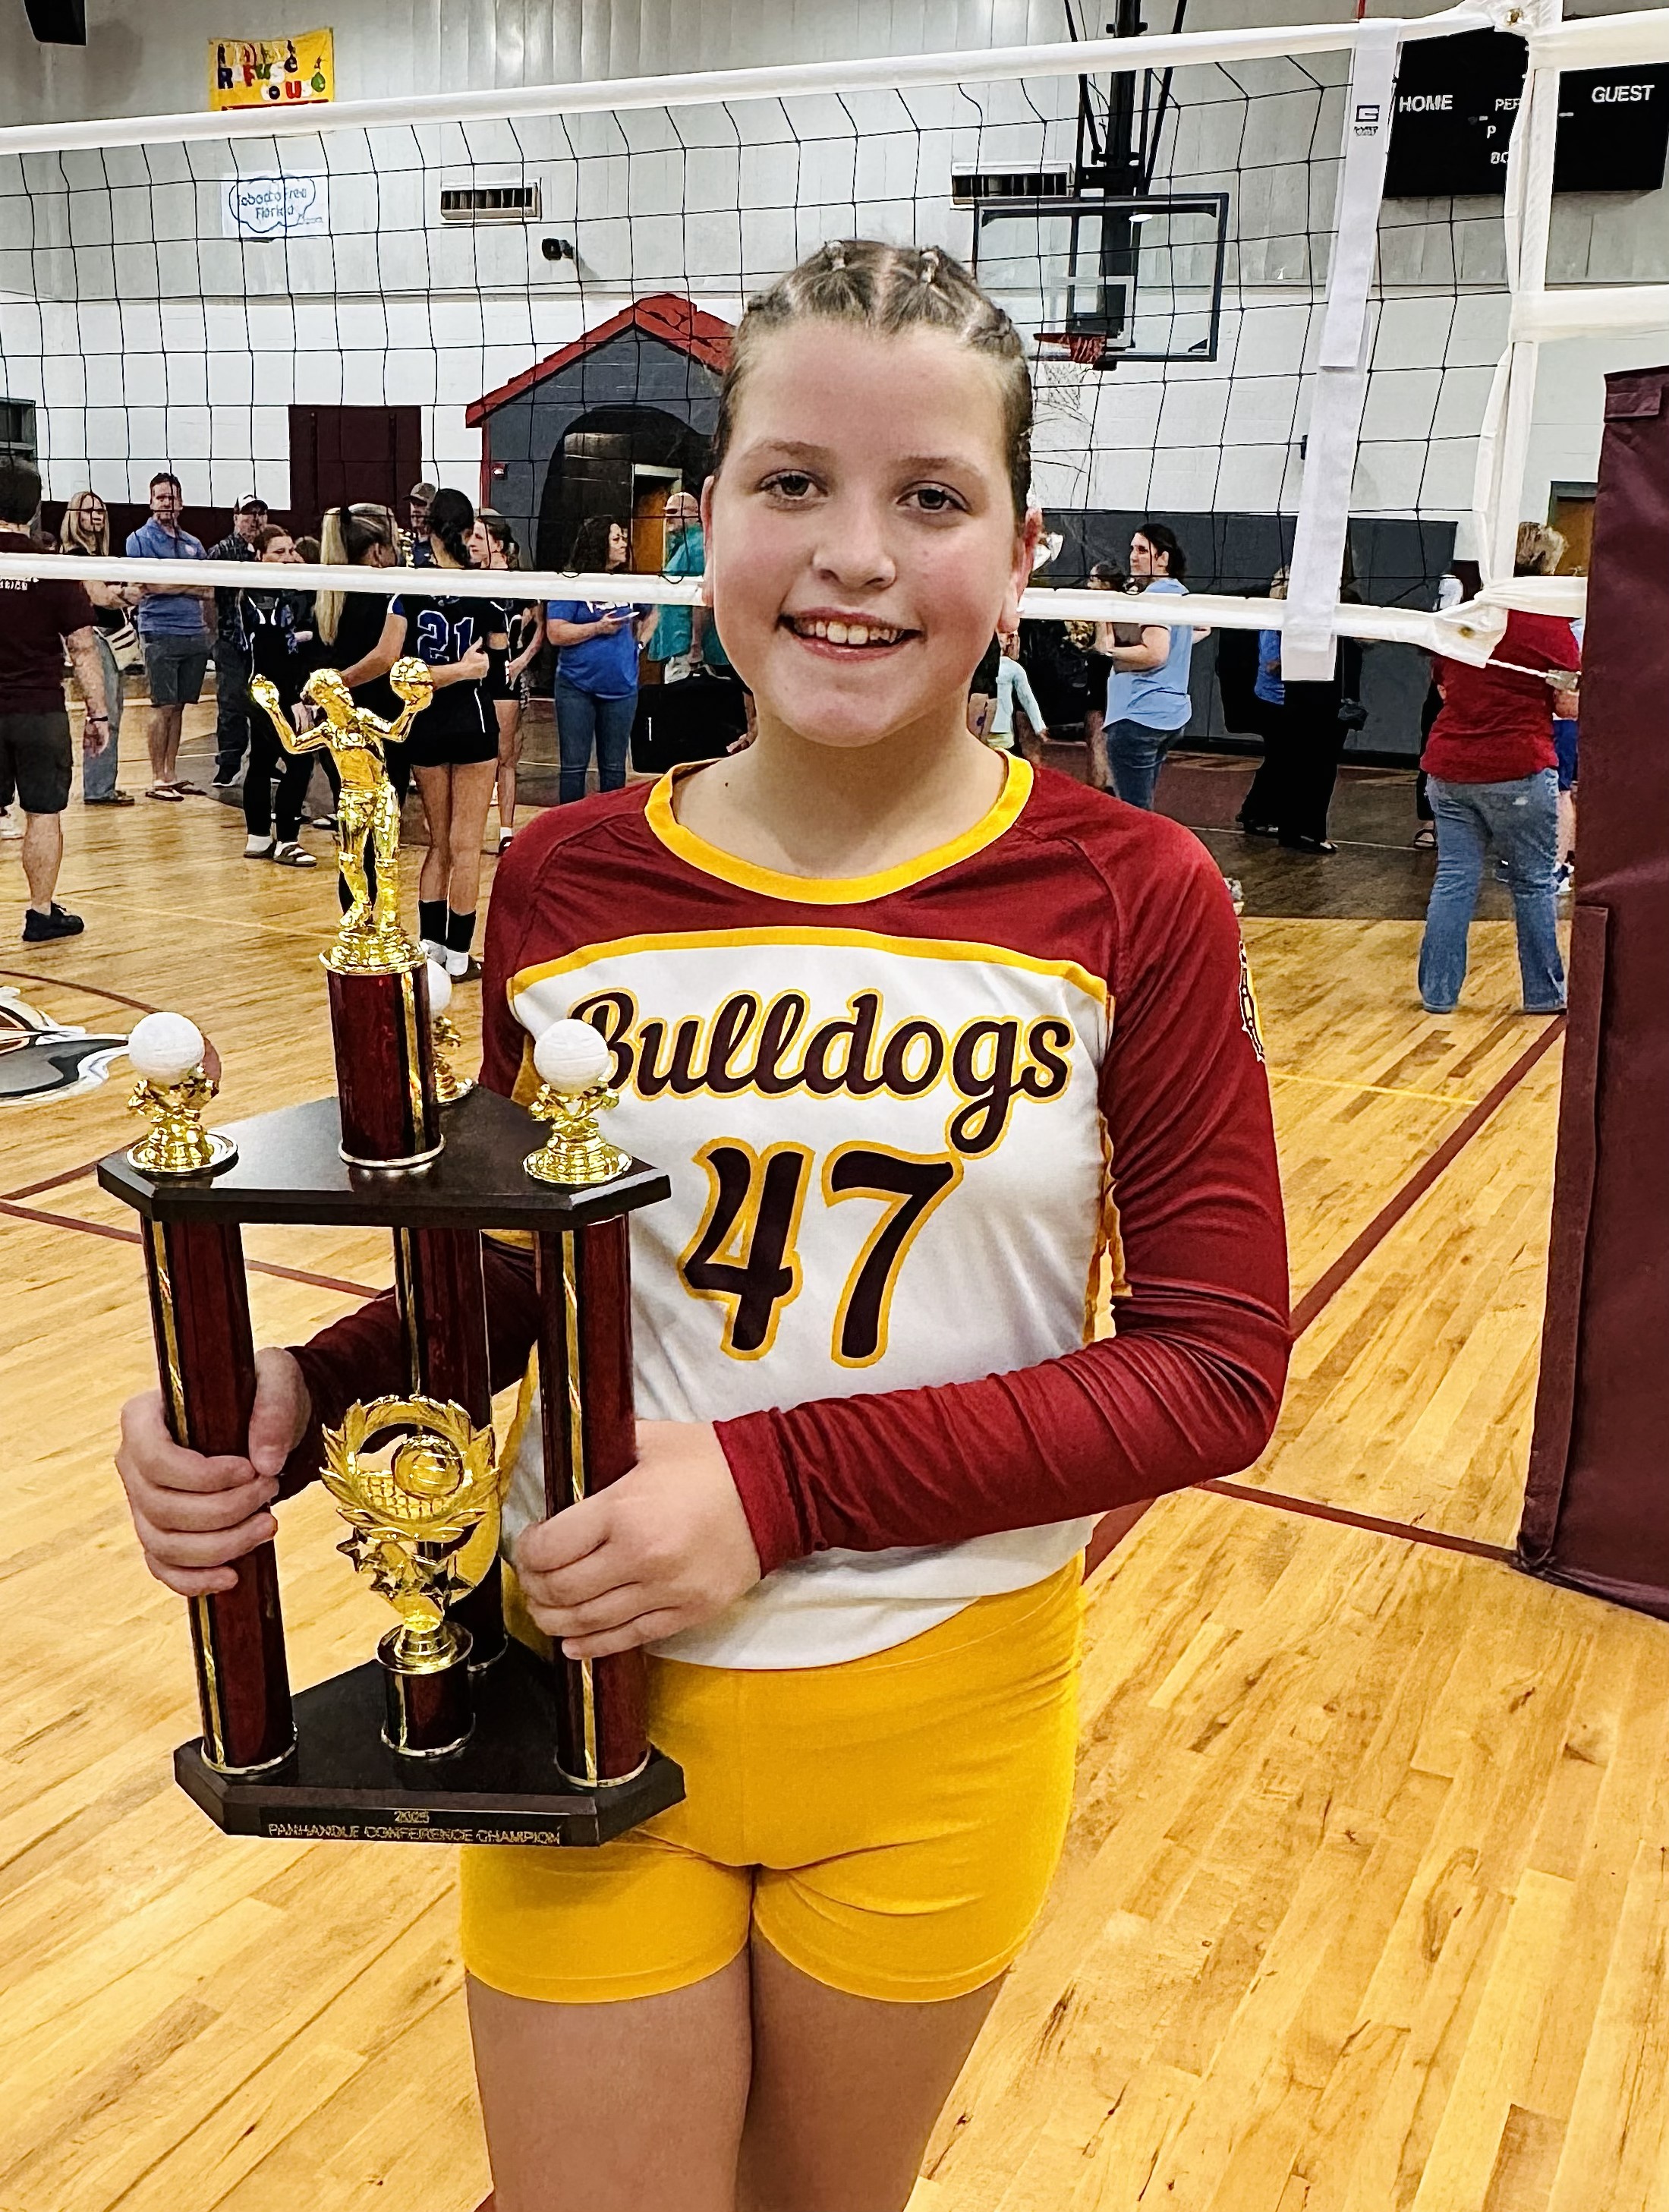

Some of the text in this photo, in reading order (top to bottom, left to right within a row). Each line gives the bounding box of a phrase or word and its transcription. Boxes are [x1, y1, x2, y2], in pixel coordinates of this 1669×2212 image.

[1399, 94, 1453, 113] HOME
[1591, 84, 1655, 104] GUEST
[417, 610, 474, 667] 21
[565, 987, 1078, 1158] Bulldogs
[677, 1136, 965, 1369] 47
[268, 1823, 561, 1845] PANHANDLE CONFERENCE CHAMPION
